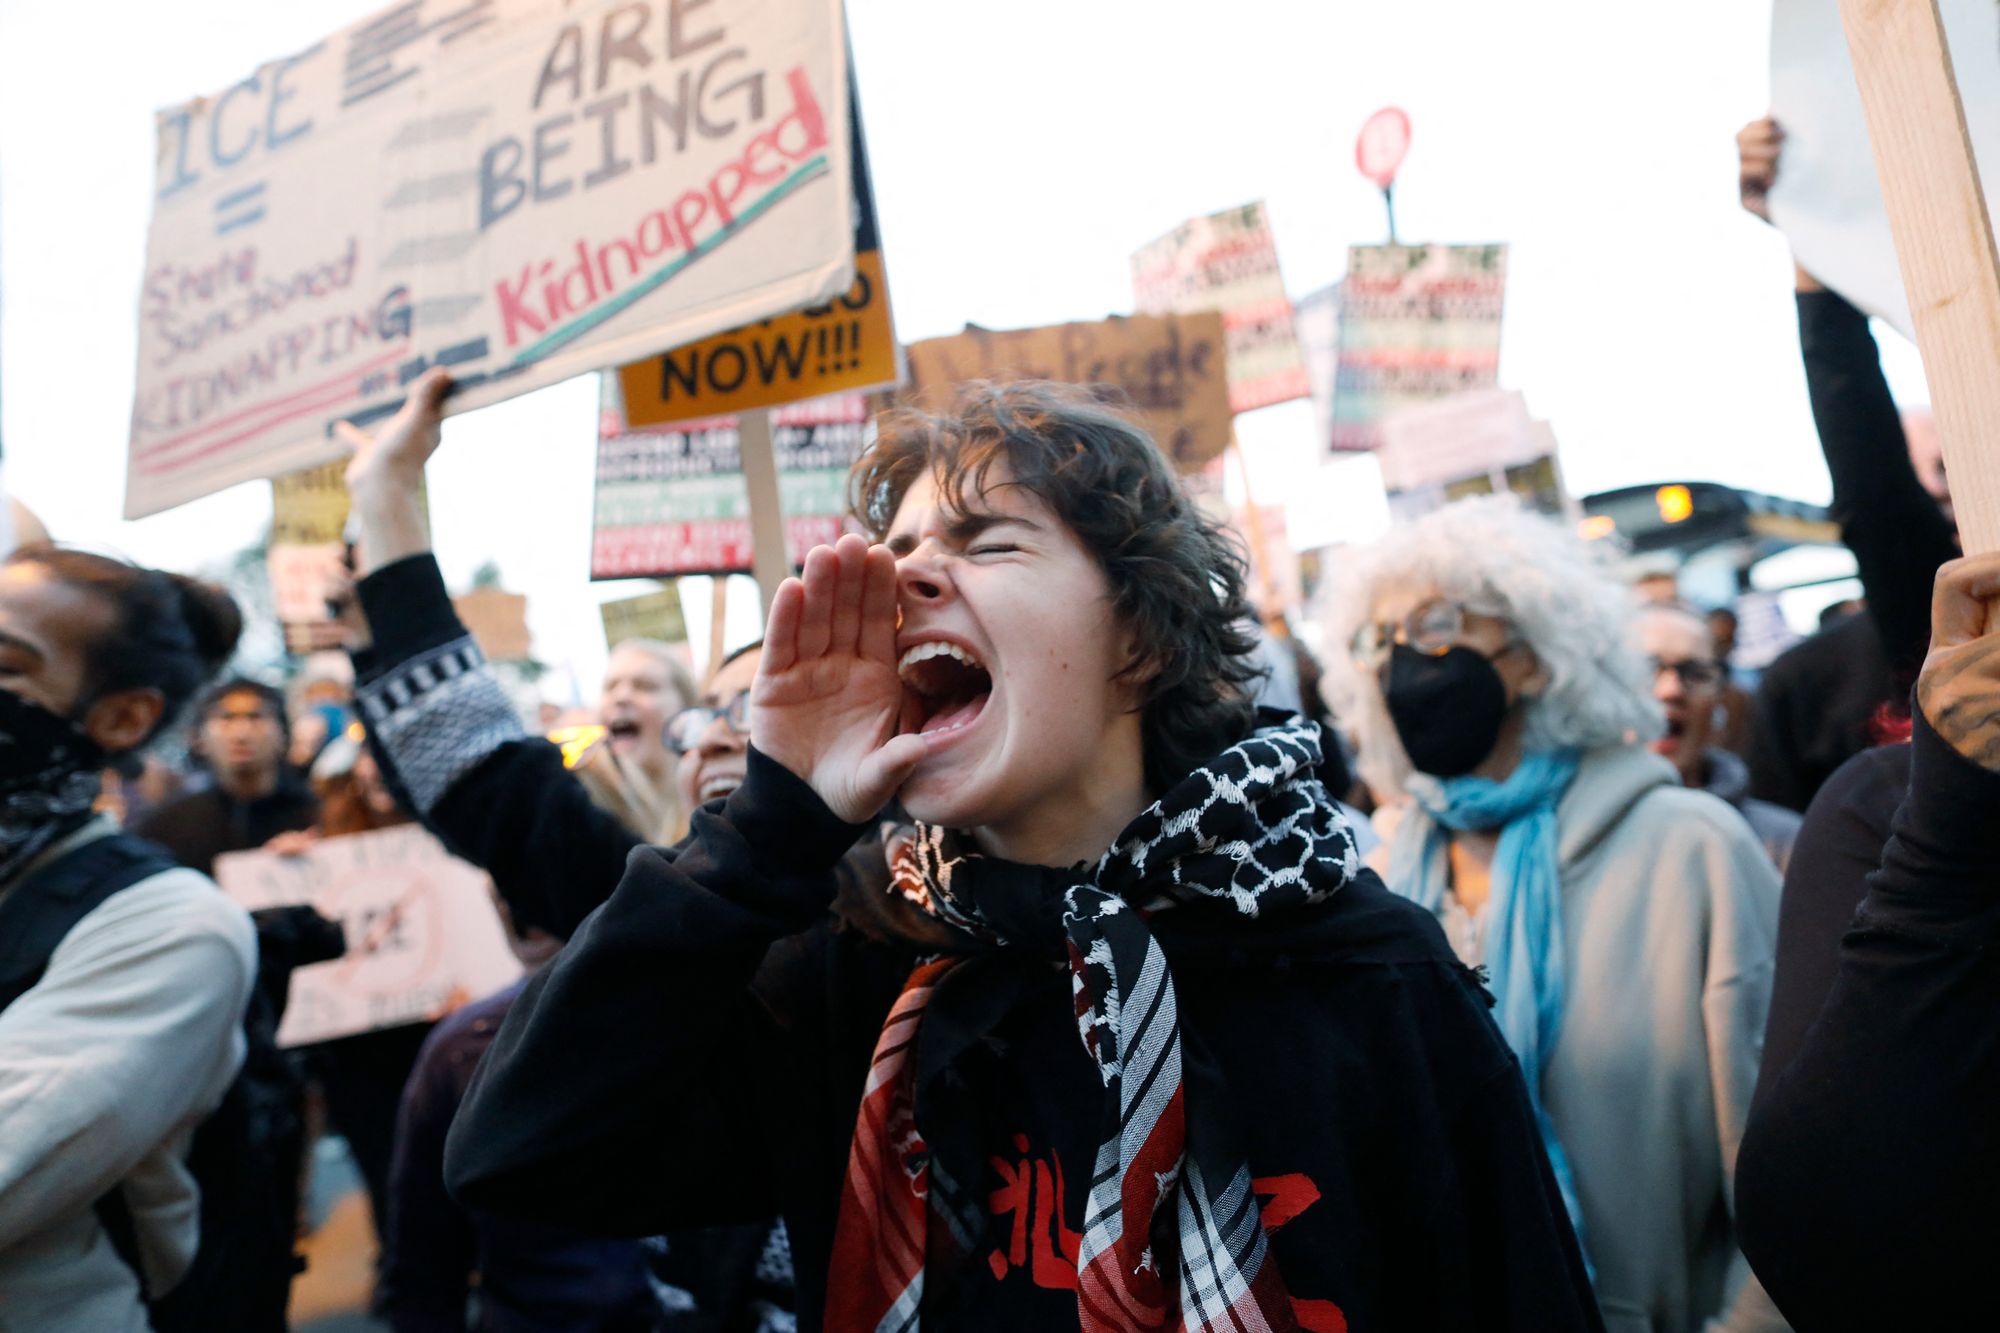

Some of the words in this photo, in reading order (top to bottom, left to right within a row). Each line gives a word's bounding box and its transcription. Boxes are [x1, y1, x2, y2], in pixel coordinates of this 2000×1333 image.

[158, 42, 325, 200] ICE
[531, 0, 727, 109] ARE
[477, 48, 767, 232] BEING
[494, 65, 828, 347] Kidnapped
[661, 320, 860, 401] NOW!!!
[801, 272, 872, 318] O
